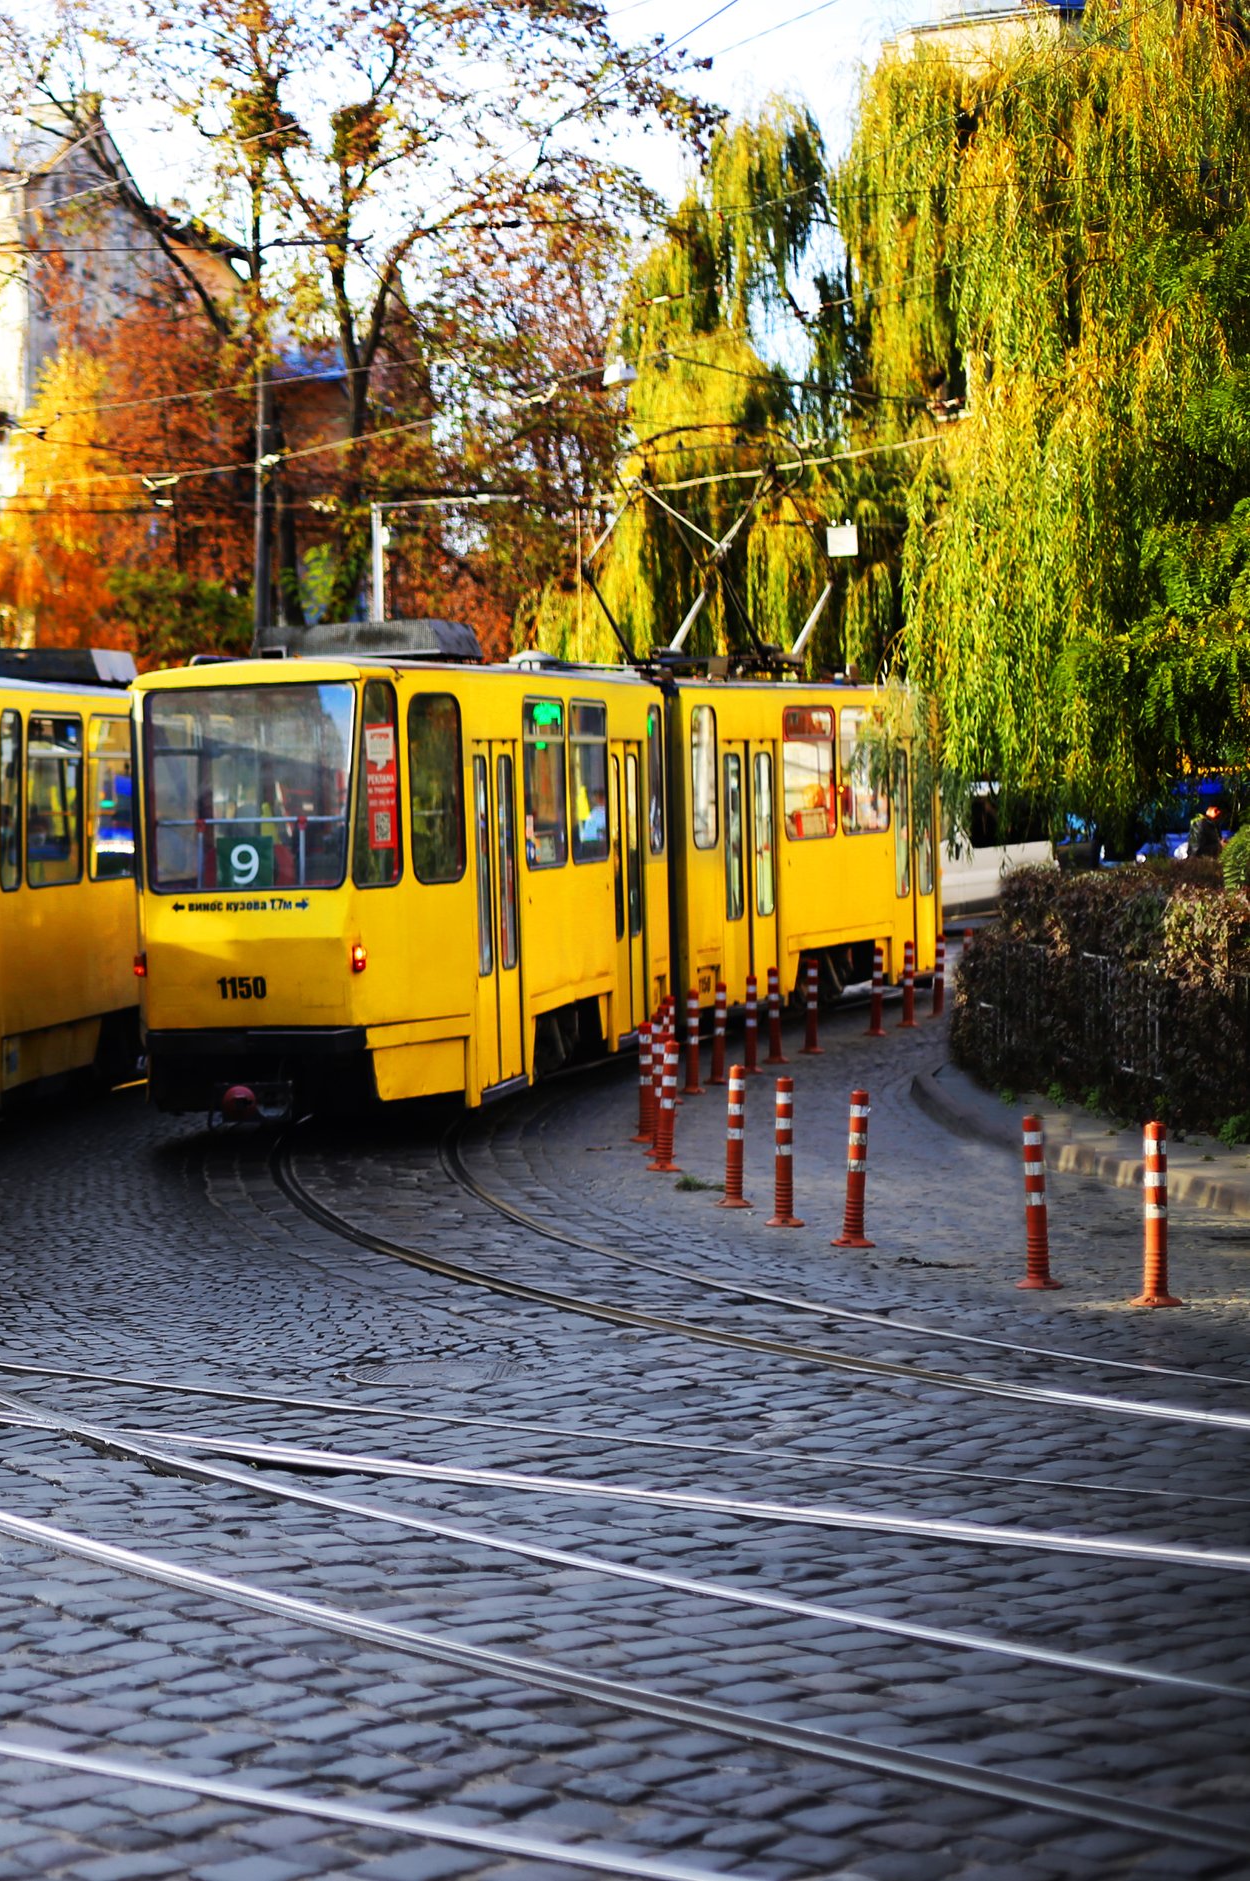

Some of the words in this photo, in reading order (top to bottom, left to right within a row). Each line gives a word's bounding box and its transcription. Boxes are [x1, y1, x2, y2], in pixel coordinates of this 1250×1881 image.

[230, 843, 260, 884] 9
[188, 902, 223, 912] винос
[226, 901, 267, 912] кузова
[217, 976, 267, 999] 1150
